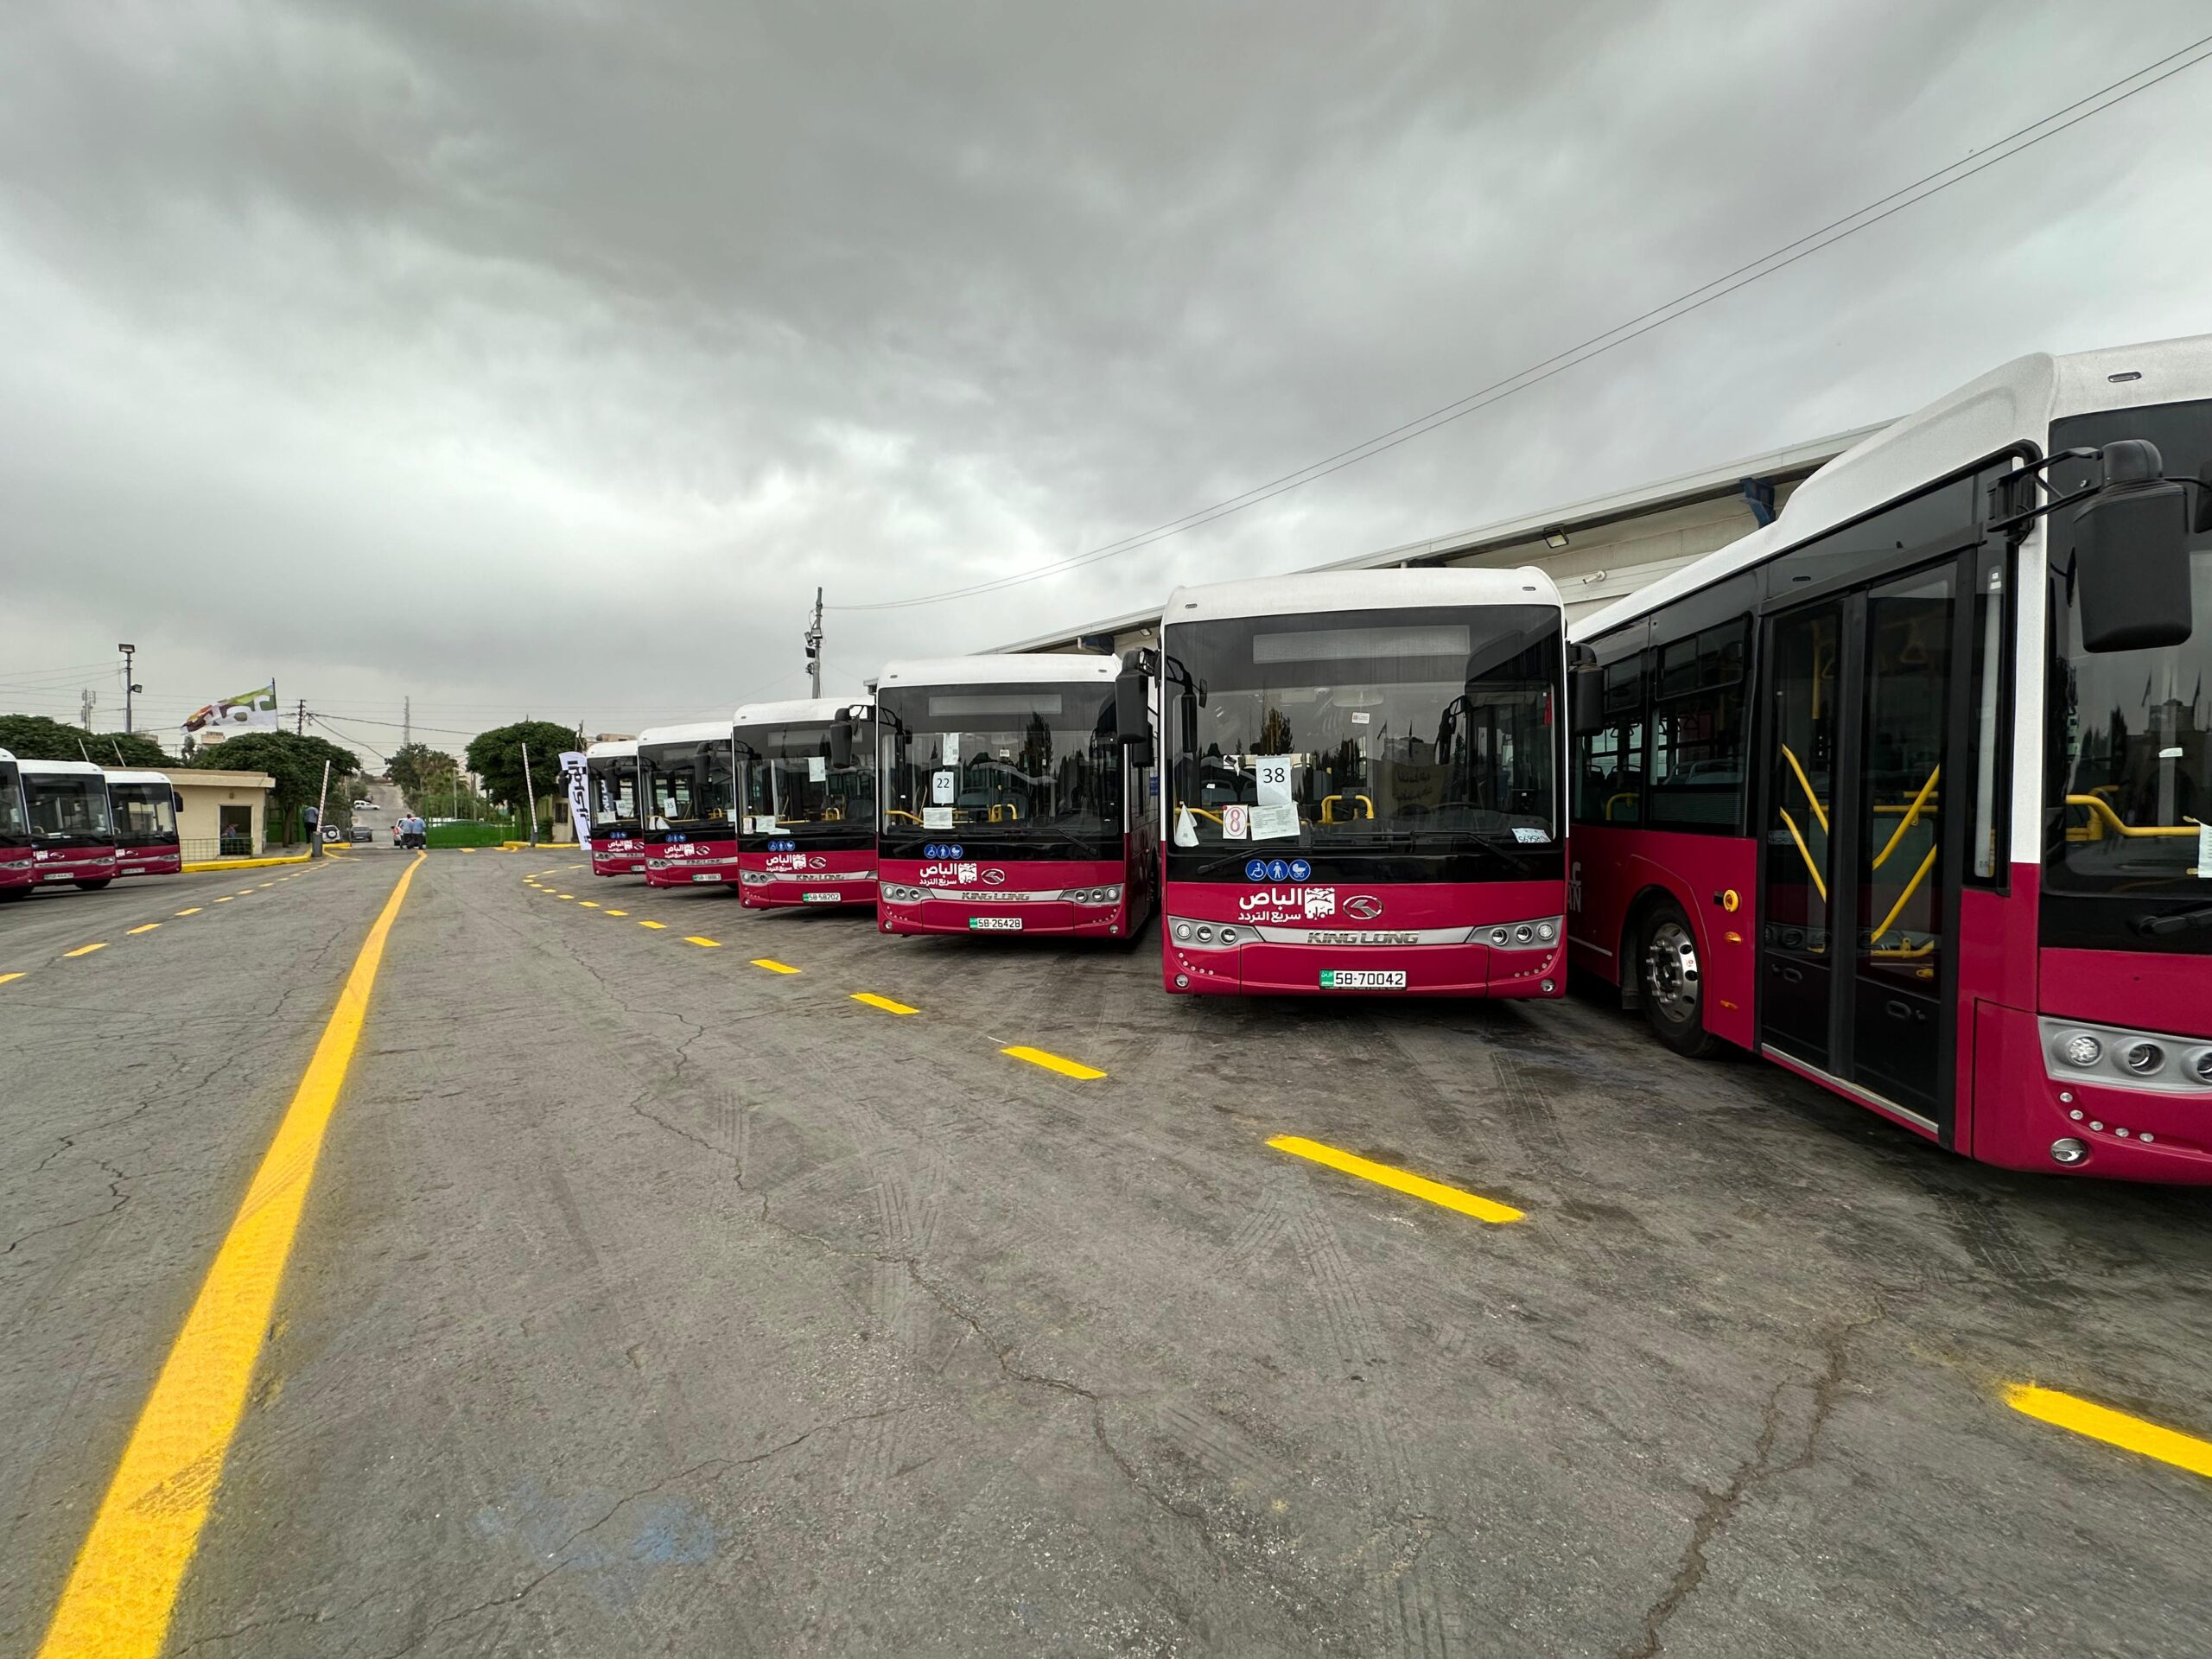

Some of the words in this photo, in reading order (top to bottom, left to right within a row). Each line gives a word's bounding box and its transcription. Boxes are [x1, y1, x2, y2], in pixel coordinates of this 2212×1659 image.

[1262, 767, 1286, 784] 38
[937, 778, 950, 789] 22
[766, 854, 792, 866] الباص
[919, 862, 957, 879] الباص
[938, 878, 957, 887] سريع
[962, 892, 993, 900] KING
[1238, 887, 1302, 911] الباص
[978, 918, 1020, 928] 58-26428
[1237, 911, 1269, 923] التردد
[1271, 911, 1301, 923] سريع
[1307, 931, 1358, 944] KING
[1360, 931, 1421, 944] LONG
[1335, 972, 1404, 986] 58-70042
